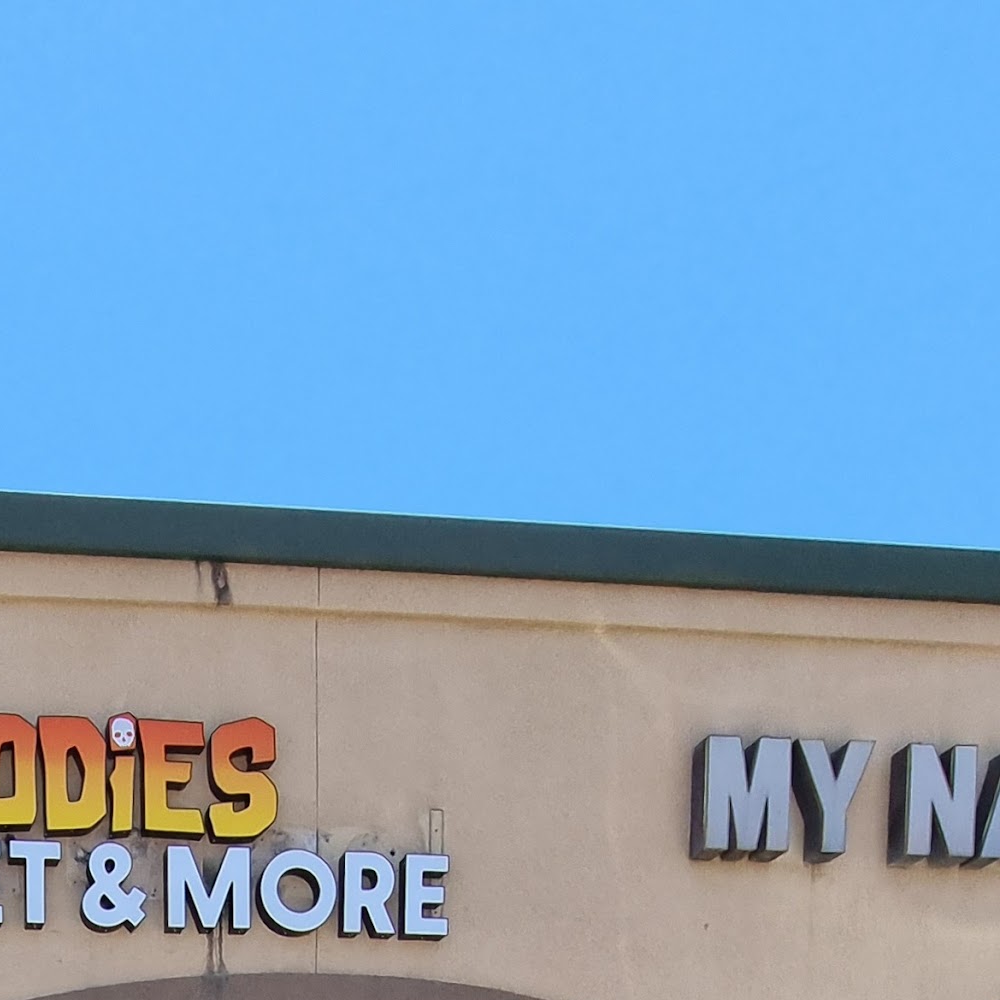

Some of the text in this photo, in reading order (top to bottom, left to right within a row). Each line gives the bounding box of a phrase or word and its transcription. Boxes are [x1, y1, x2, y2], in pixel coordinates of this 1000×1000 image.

[691, 735, 875, 863] MY
[80, 841, 146, 933] &
[164, 843, 450, 940] MORE
